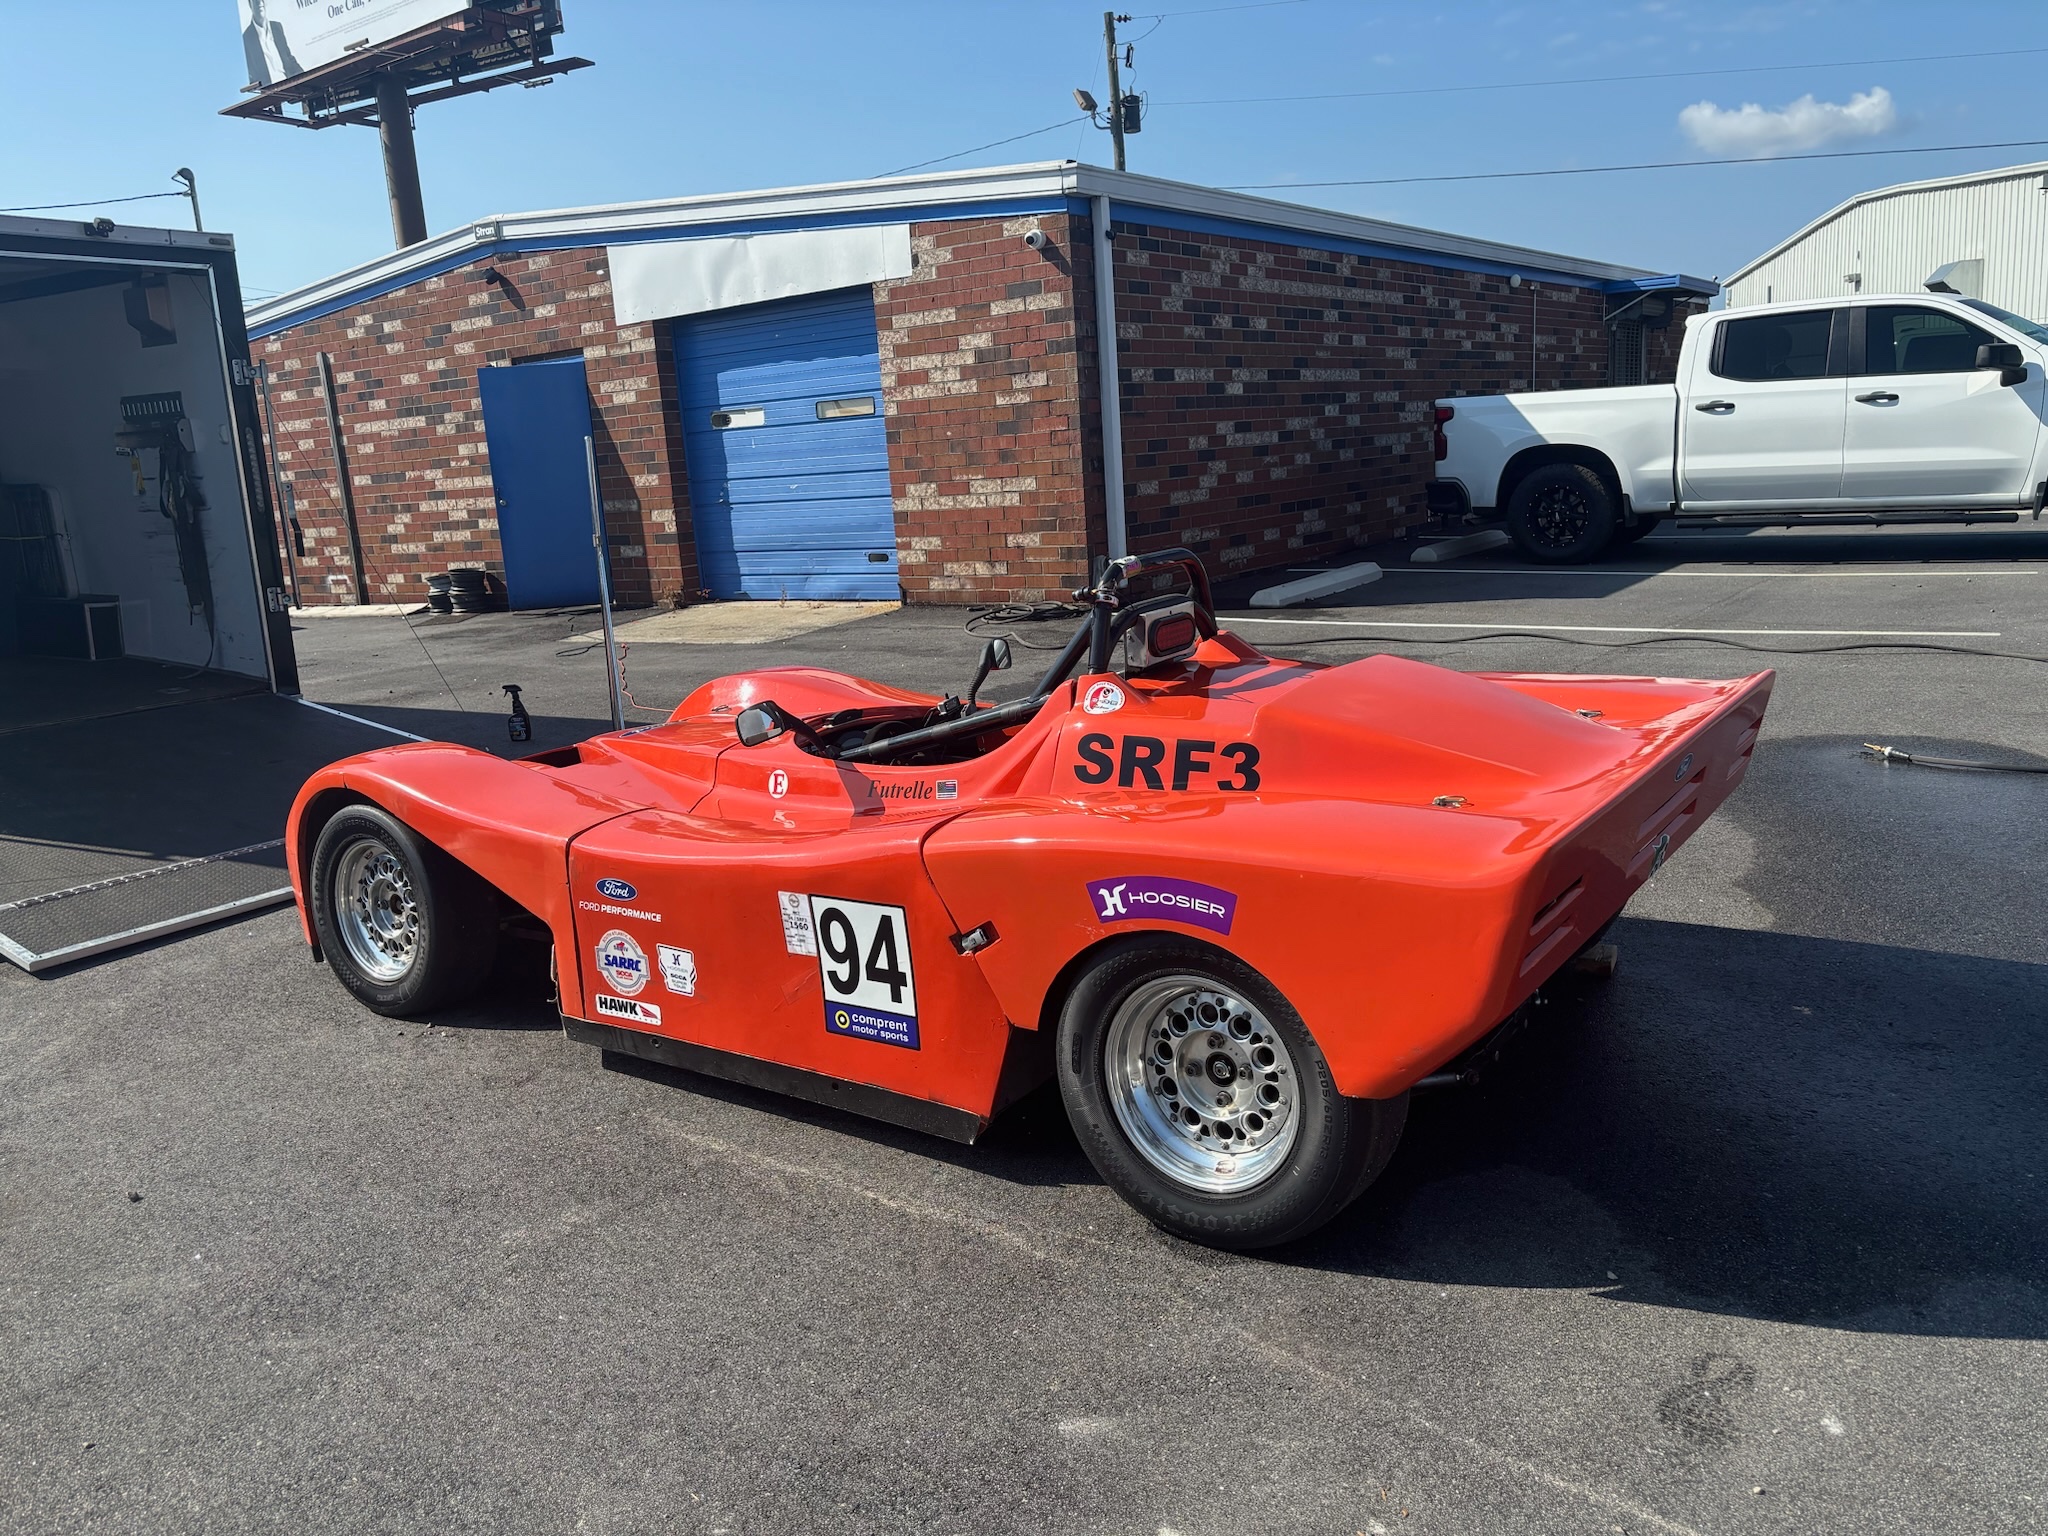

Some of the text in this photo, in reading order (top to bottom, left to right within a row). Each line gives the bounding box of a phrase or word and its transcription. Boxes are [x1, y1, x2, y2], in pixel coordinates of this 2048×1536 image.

[327, 4, 344, 18] One
[475, 226, 495, 237] Stran
[1073, 733, 1261, 792] SRF3
[772, 773, 785, 796] E
[867, 779, 933, 800] Futrelle
[604, 880, 630, 898] Ford
[578, 900, 662, 923] FORD PERFORMANCE
[1128, 891, 1226, 919] HOOSIER
[604, 954, 642, 972] SARRC
[820, 907, 908, 1004] 94
[615, 969, 633, 977] SCCA
[670, 973, 687, 981] SCCA
[598, 996, 639, 1016] HAWK
[851, 1013, 908, 1032] comprent
[852, 1024, 909, 1042] motor sports
